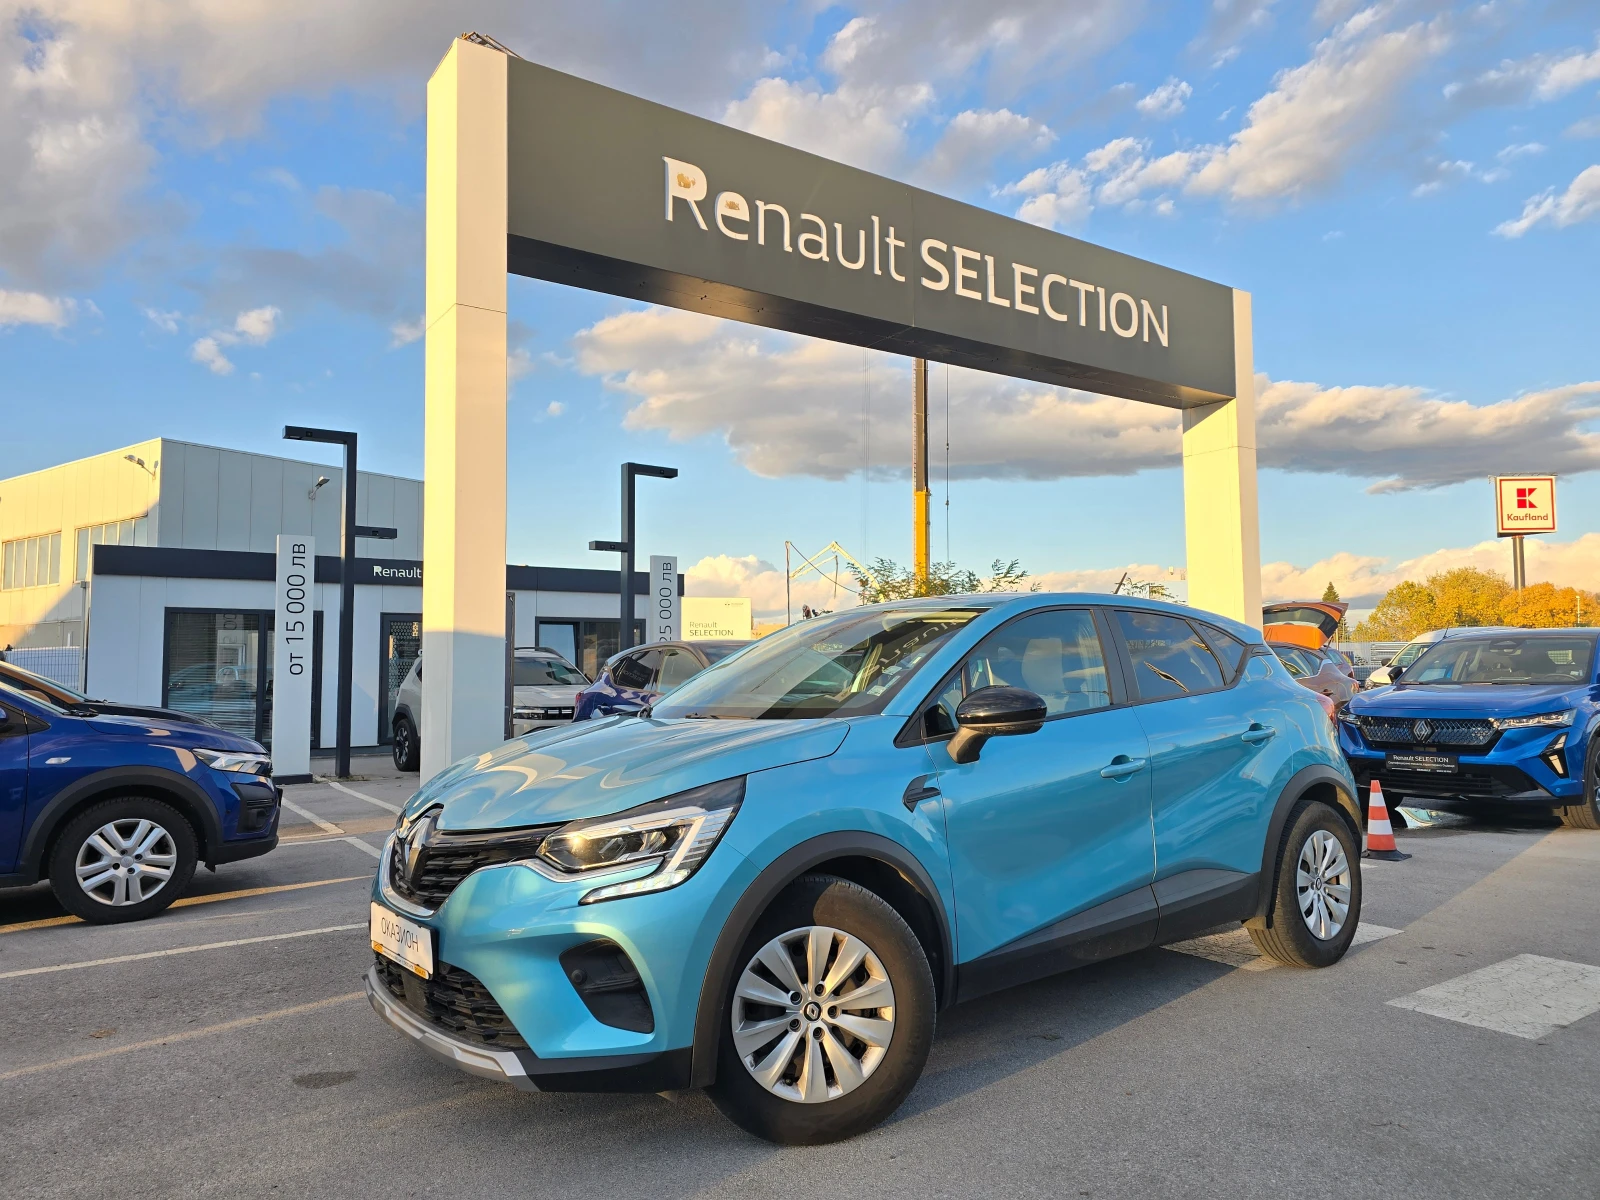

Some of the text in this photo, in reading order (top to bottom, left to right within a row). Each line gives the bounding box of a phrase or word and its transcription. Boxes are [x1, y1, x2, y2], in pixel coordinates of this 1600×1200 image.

[662, 155, 1169, 348] Renault SELECTION
[1507, 513, 1548, 521] Kaufland
[373, 565, 422, 578] Renault
[286, 574, 306, 614] 000
[659, 587, 672, 620] 000
[285, 621, 305, 645] 15
[689, 629, 734, 637] SELECTION
[381, 917, 419, 952] ОКАЗИОН
